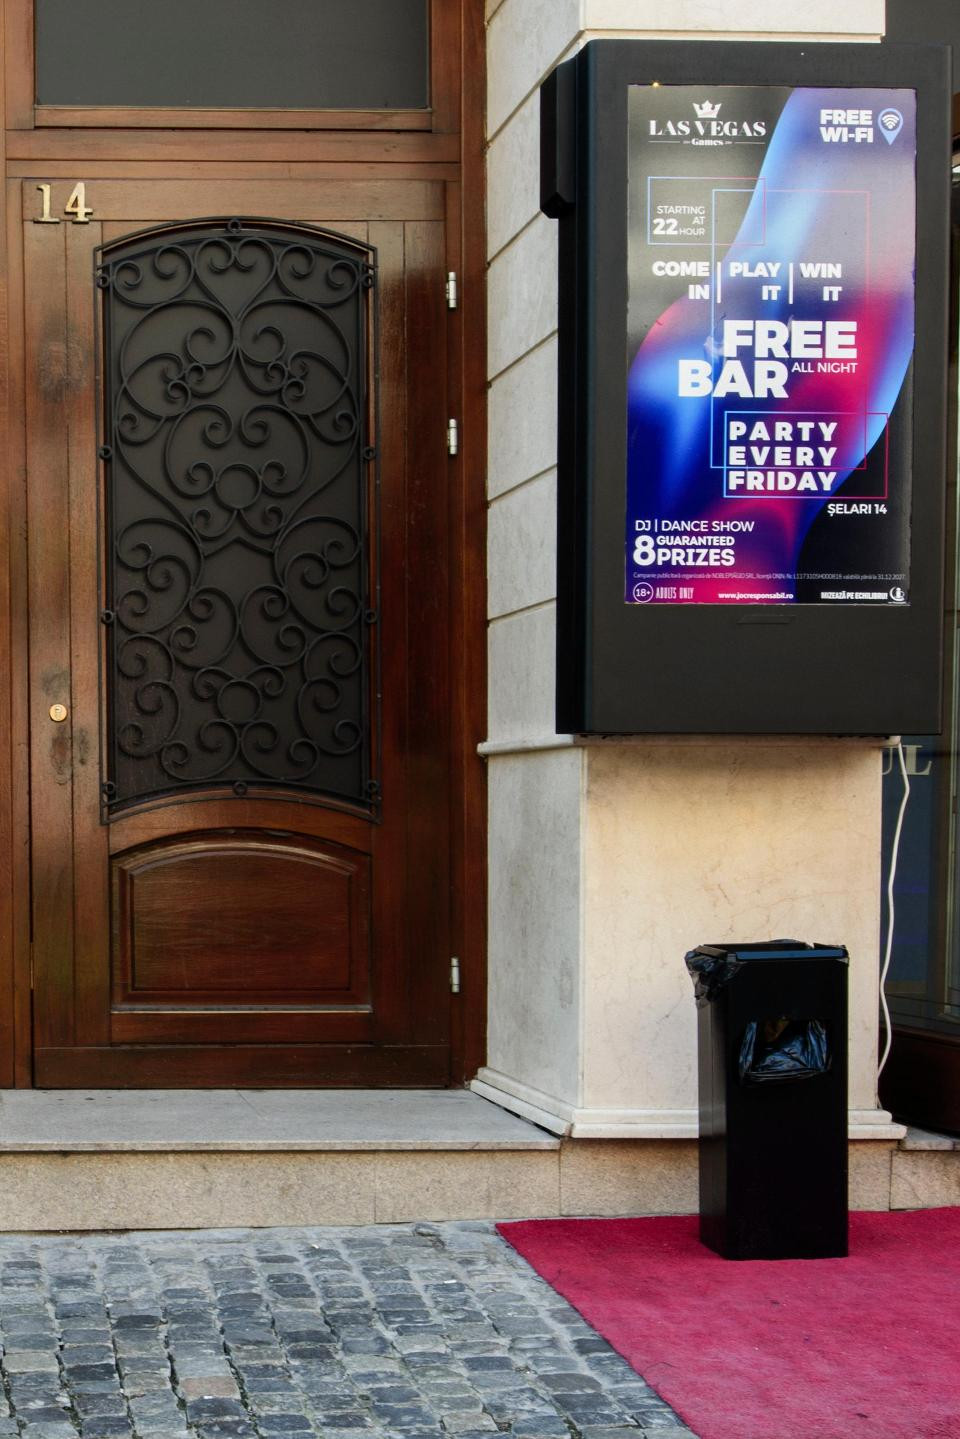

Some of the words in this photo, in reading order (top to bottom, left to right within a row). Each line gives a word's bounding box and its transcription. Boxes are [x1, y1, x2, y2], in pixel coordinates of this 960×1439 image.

[820, 109, 873, 125] FREE
[649, 120, 690, 136] LAS
[691, 120, 767, 137] VEGAS
[820, 127, 873, 143] WI-FI
[691, 137, 724, 146] Games
[33, 182, 94, 225] 14
[656, 205, 705, 215] STARTING
[653, 218, 678, 235] 22
[679, 227, 705, 236] HOUR
[692, 216, 705, 225] AT
[652, 261, 710, 277] COME
[730, 262, 782, 278] PLAY
[799, 263, 842, 278] WIN
[688, 284, 710, 299] IN
[762, 285, 782, 300] IT
[823, 286, 842, 301] IT
[723, 319, 857, 359] FREE
[791, 362, 814, 373] ALL
[817, 362, 858, 374] NIGHT
[678, 359, 789, 398] BAR
[729, 421, 838, 442] PARTY
[729, 446, 837, 466] EVERY
[729, 471, 837, 491] FRIDAY
[827, 503, 872, 517] ȘELARI
[874, 503, 887, 515] 14
[635, 520, 651, 532] DJ
[661, 520, 709, 532] DANCE
[711, 520, 755, 532] SHOW
[633, 534, 656, 566] 8
[656, 535, 735, 546] GUARANTEED
[656, 547, 735, 566] PRIZES
[636, 588, 651, 597] 18+
[679, 587, 694, 599] ONLY
[718, 591, 794, 600] www.jocresponsabil.ro
